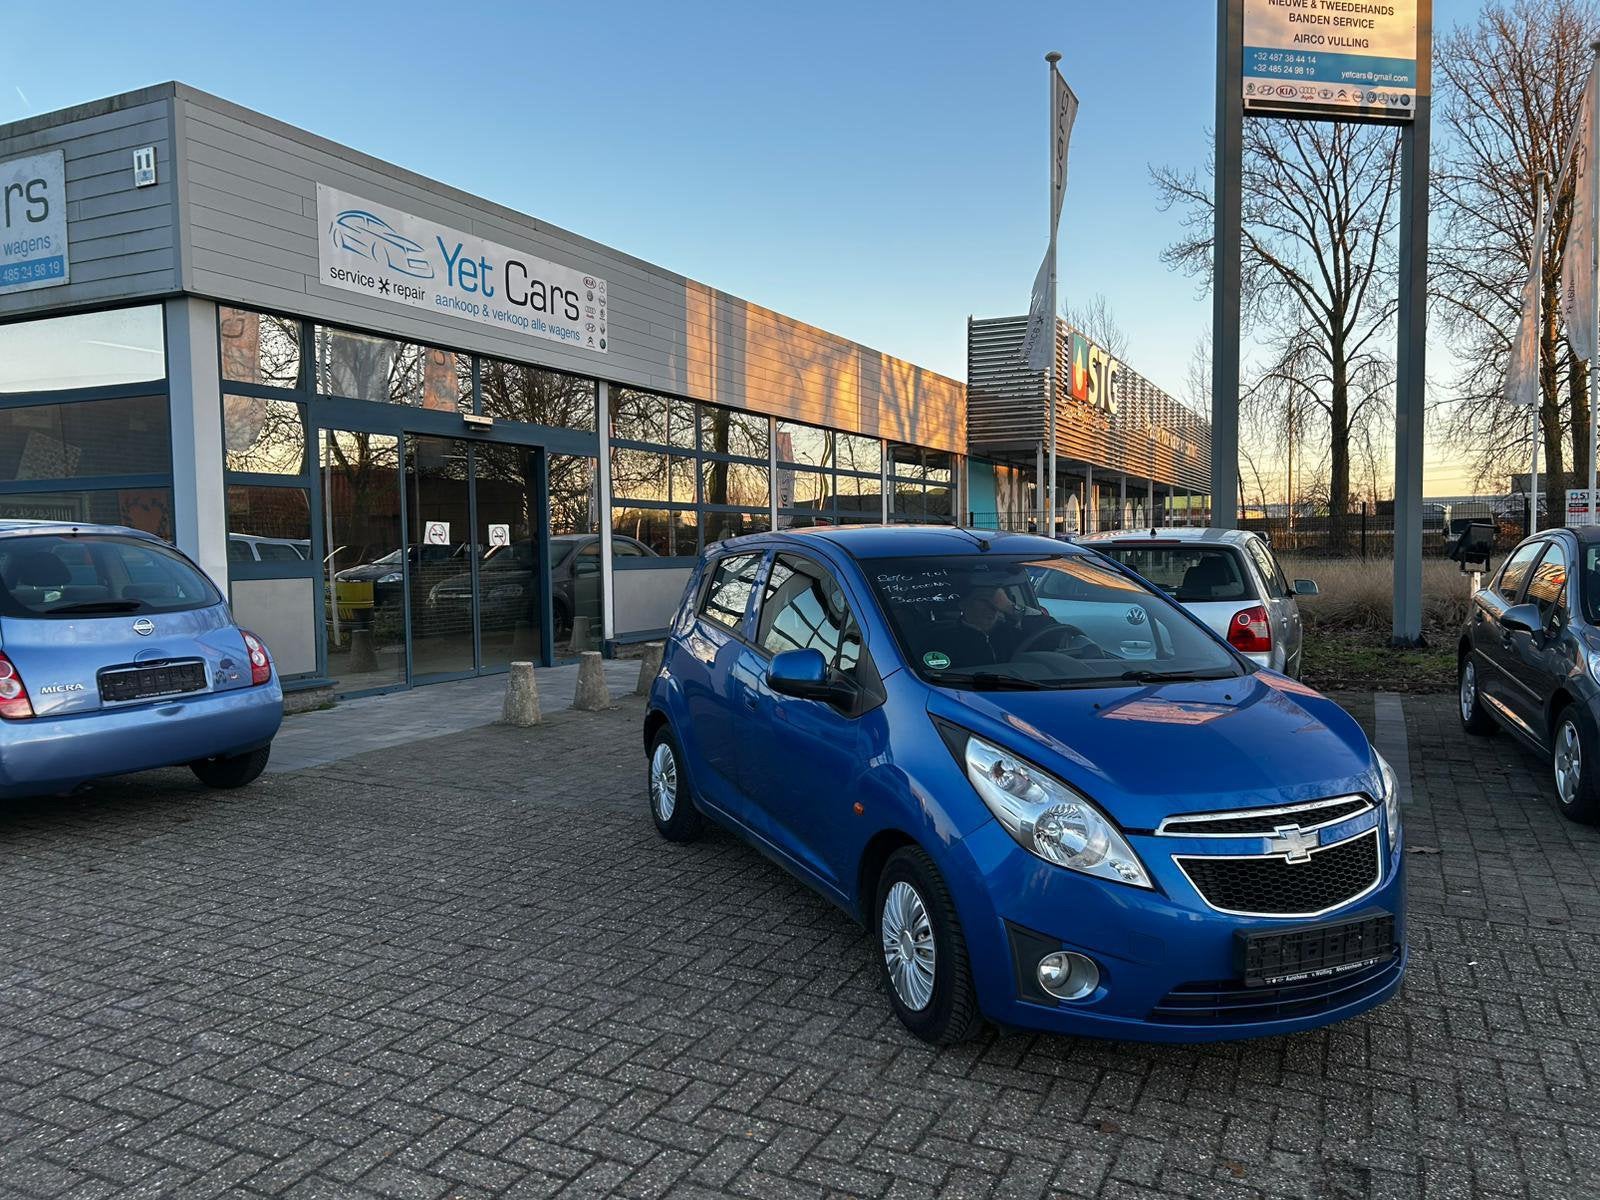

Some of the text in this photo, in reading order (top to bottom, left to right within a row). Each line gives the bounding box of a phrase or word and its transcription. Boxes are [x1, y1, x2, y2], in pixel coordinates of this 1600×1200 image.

[1268, 0, 1395, 16] NIEUWE & TWEEDEHANDS
[1288, 13, 1375, 29] BANDEN SERVICE
[1293, 33, 1369, 48] AIRCO VULLING
[1269, 53, 1283, 62] 487
[1285, 54, 1294, 63] 38
[1296, 55, 1305, 64] 44
[1308, 56, 1316, 64] 14
[1269, 65, 1282, 73] 485
[1283, 65, 1293, 74] 24
[1294, 66, 1304, 75] 98
[1306, 67, 1315, 75] 19
[3, 236, 51, 257] wagens
[3, 262, 60, 281] 485 24 98 19
[436, 235, 580, 321] Yet Cars
[330, 266, 425, 300] service repair
[435, 294, 581, 341] aankoop & verkoop alle wagens
[1088, 344, 1118, 415] STG
[41, 683, 84, 694] MICRA
